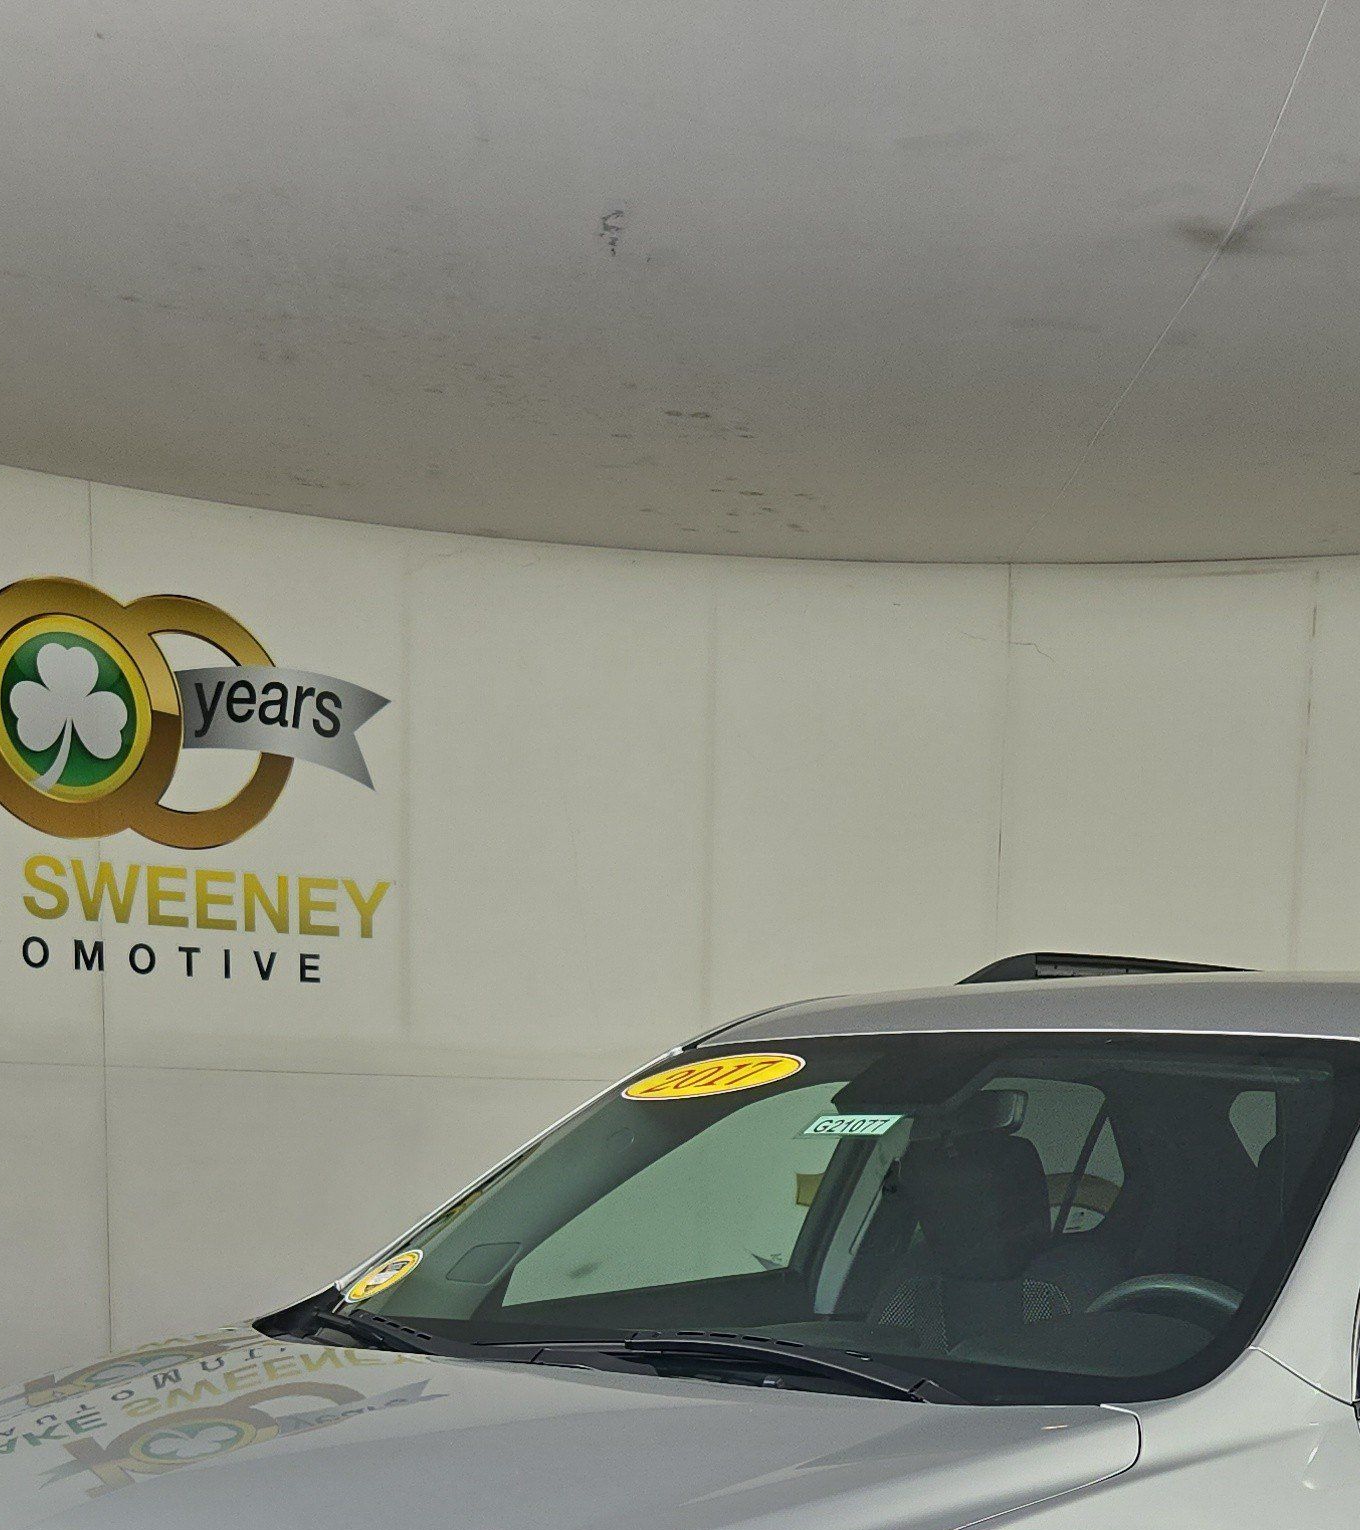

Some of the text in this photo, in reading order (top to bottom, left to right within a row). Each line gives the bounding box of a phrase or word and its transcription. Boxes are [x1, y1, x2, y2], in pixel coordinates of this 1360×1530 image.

[194, 678, 343, 738] years
[22, 854, 392, 938] SWEENEY
[640, 1060, 783, 1095] 2017
[813, 1117, 889, 1134] G21077
